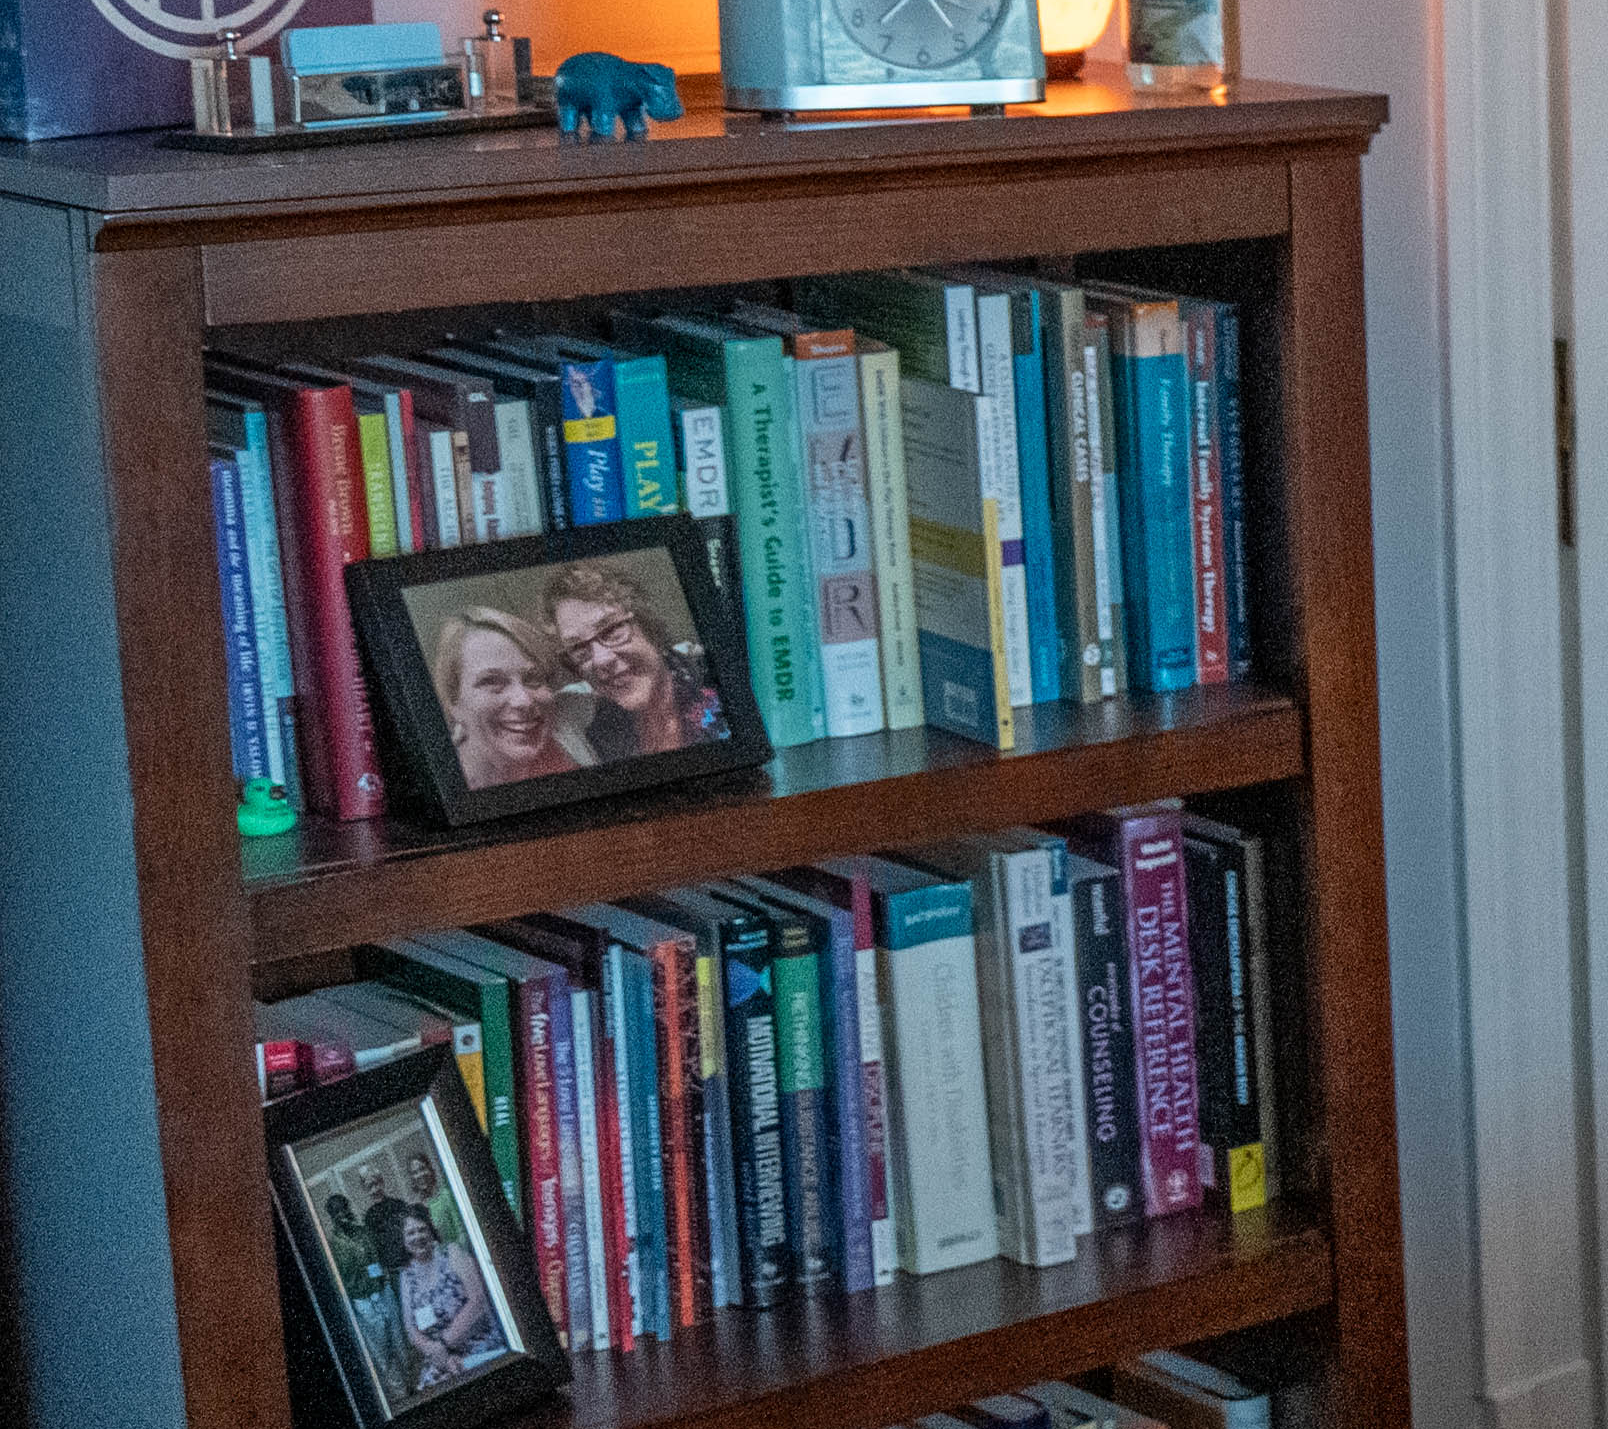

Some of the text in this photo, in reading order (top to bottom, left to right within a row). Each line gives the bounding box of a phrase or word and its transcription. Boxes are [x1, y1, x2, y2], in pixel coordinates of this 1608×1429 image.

[852, 9, 863, 28] 8
[878, 34, 892, 54] 7
[953, 32, 966, 53] 5
[978, 8, 991, 24] 4
[917, 49, 930, 66] 6
[1068, 370, 1090, 484] CLINICAL CASES
[1193, 380, 1211, 446] Internal
[585, 449, 609, 493] Play
[632, 439, 664, 513] PLAY
[690, 414, 721, 509] EMDR
[1156, 431, 1174, 488] Therapy
[1193, 449, 1212, 501] Family
[335, 478, 356, 535] Brown
[1194, 504, 1214, 567] Systems
[748, 381, 794, 703] A Therapist's Guide to EMDR
[226, 572, 249, 633] meaning
[1197, 571, 1216, 633] Therapy
[1136, 904, 1163, 974] DESK
[528, 1011, 549, 1045] five
[789, 991, 812, 1090] RETHINKING
[1037, 956, 1061, 1075] EXCEPTIONAL
[1159, 879, 1195, 1152] THE MENTAL HEALTH
[532, 1044, 550, 1083] Love
[939, 1041, 964, 1084] with
[1027, 1064, 1045, 1107] Special
[1086, 984, 1117, 1144] COUNSELING
[1141, 982, 1173, 1139] REFERENCE
[531, 1082, 555, 1162] Languages
[743, 1014, 786, 1247] MOTIVATIONAL INTERVIEWING
[795, 1092, 820, 1187] SUBSTANCE
[1032, 1111, 1050, 1176] Education
[1046, 1082, 1068, 1176] LEARNERS
[537, 1175, 561, 1248] Teenagers
